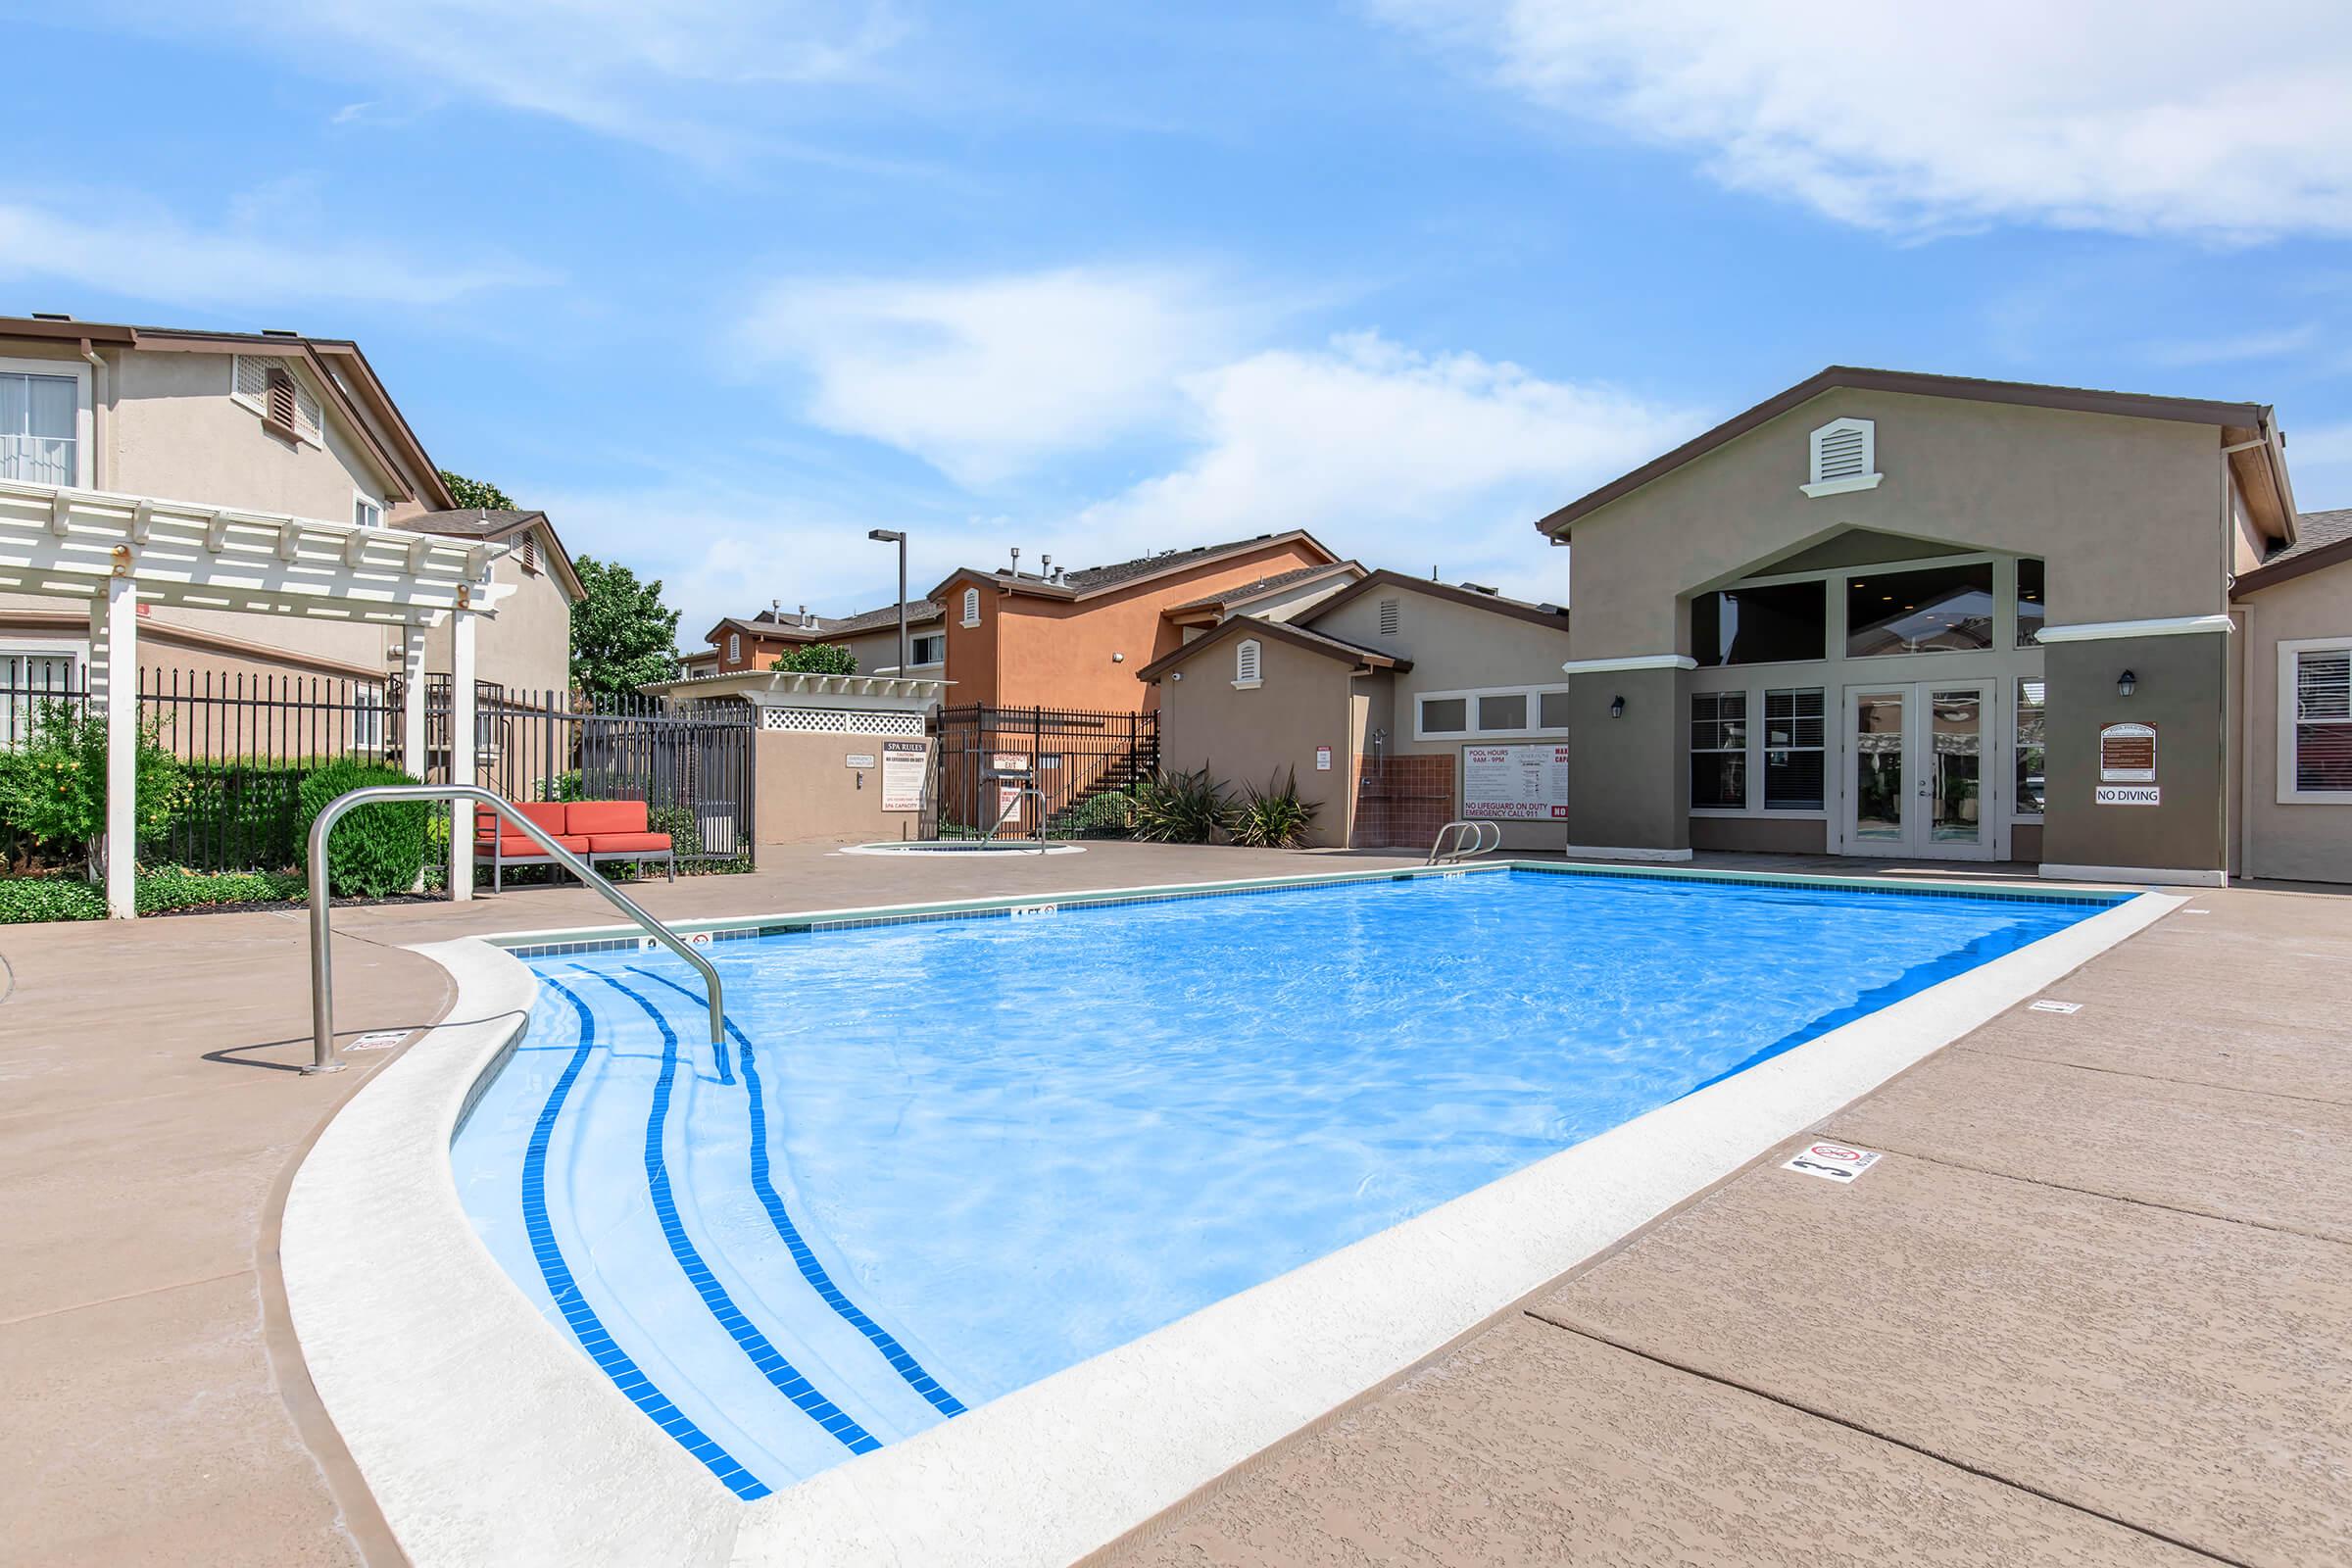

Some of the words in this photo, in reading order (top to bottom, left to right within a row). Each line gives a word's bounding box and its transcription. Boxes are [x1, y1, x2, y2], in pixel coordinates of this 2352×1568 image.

[2097, 791, 2116, 801] NO
[2118, 791, 2158, 801] DIVING
[1792, 1160, 1853, 1178] 3
